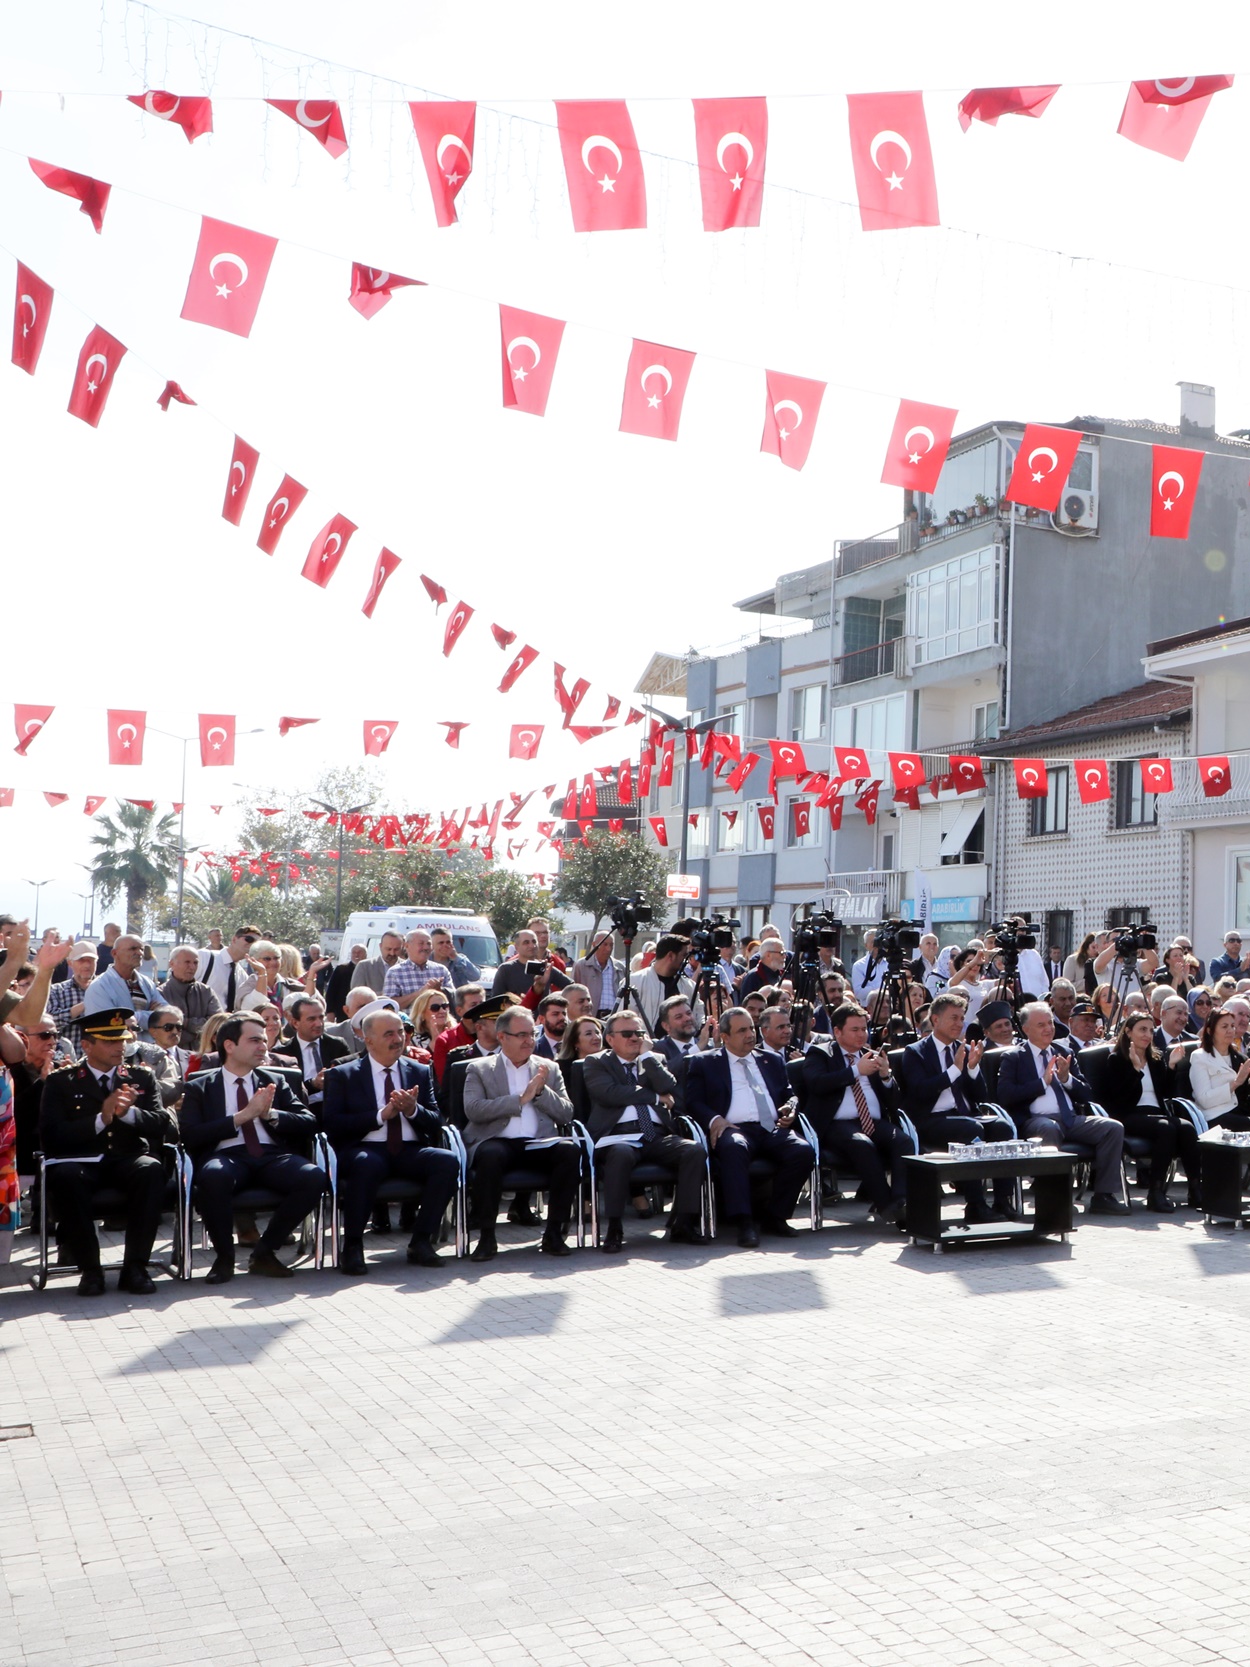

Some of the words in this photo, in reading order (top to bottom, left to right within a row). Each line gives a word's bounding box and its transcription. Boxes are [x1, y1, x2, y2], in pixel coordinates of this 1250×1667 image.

[838, 897, 879, 918] EMLAK
[931, 899, 965, 914] ARABİRLİK
[416, 923, 481, 933] AMBULANS
